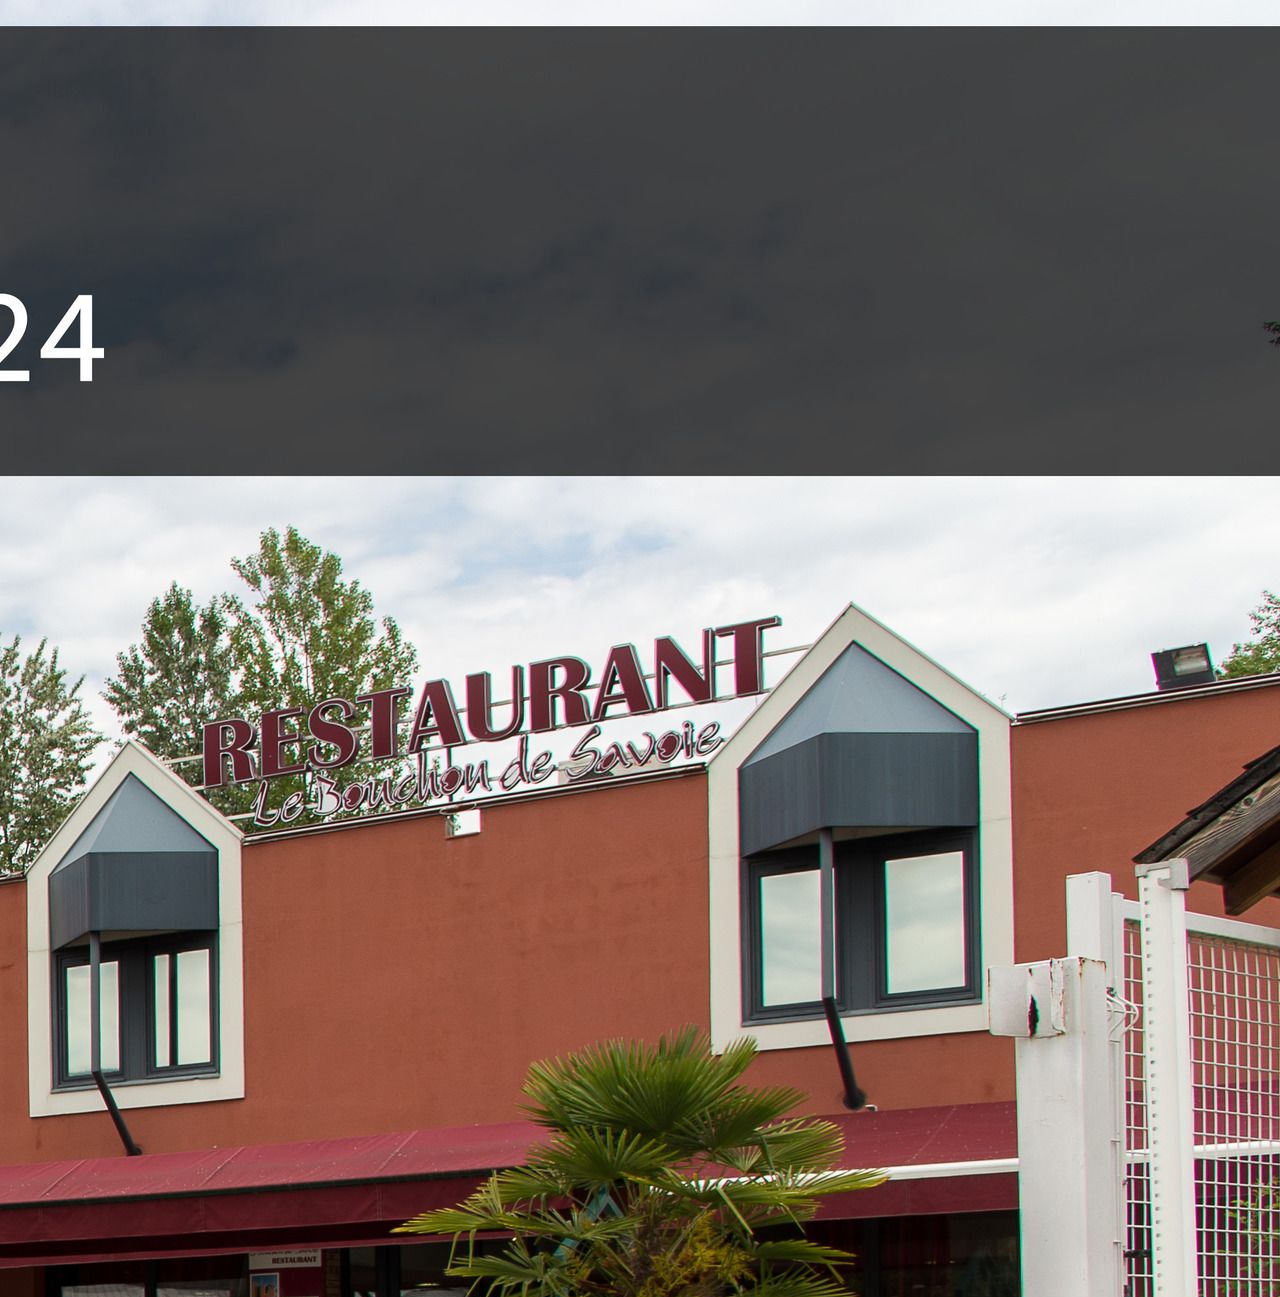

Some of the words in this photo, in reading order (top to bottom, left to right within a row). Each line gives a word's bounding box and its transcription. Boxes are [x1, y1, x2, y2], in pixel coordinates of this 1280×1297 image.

[203, 616, 781, 789] RESTAURANT
[251, 779, 304, 826] Le
[313, 751, 492, 816] Bouchon
[499, 733, 555, 791] de
[565, 720, 724, 780] Savoie
